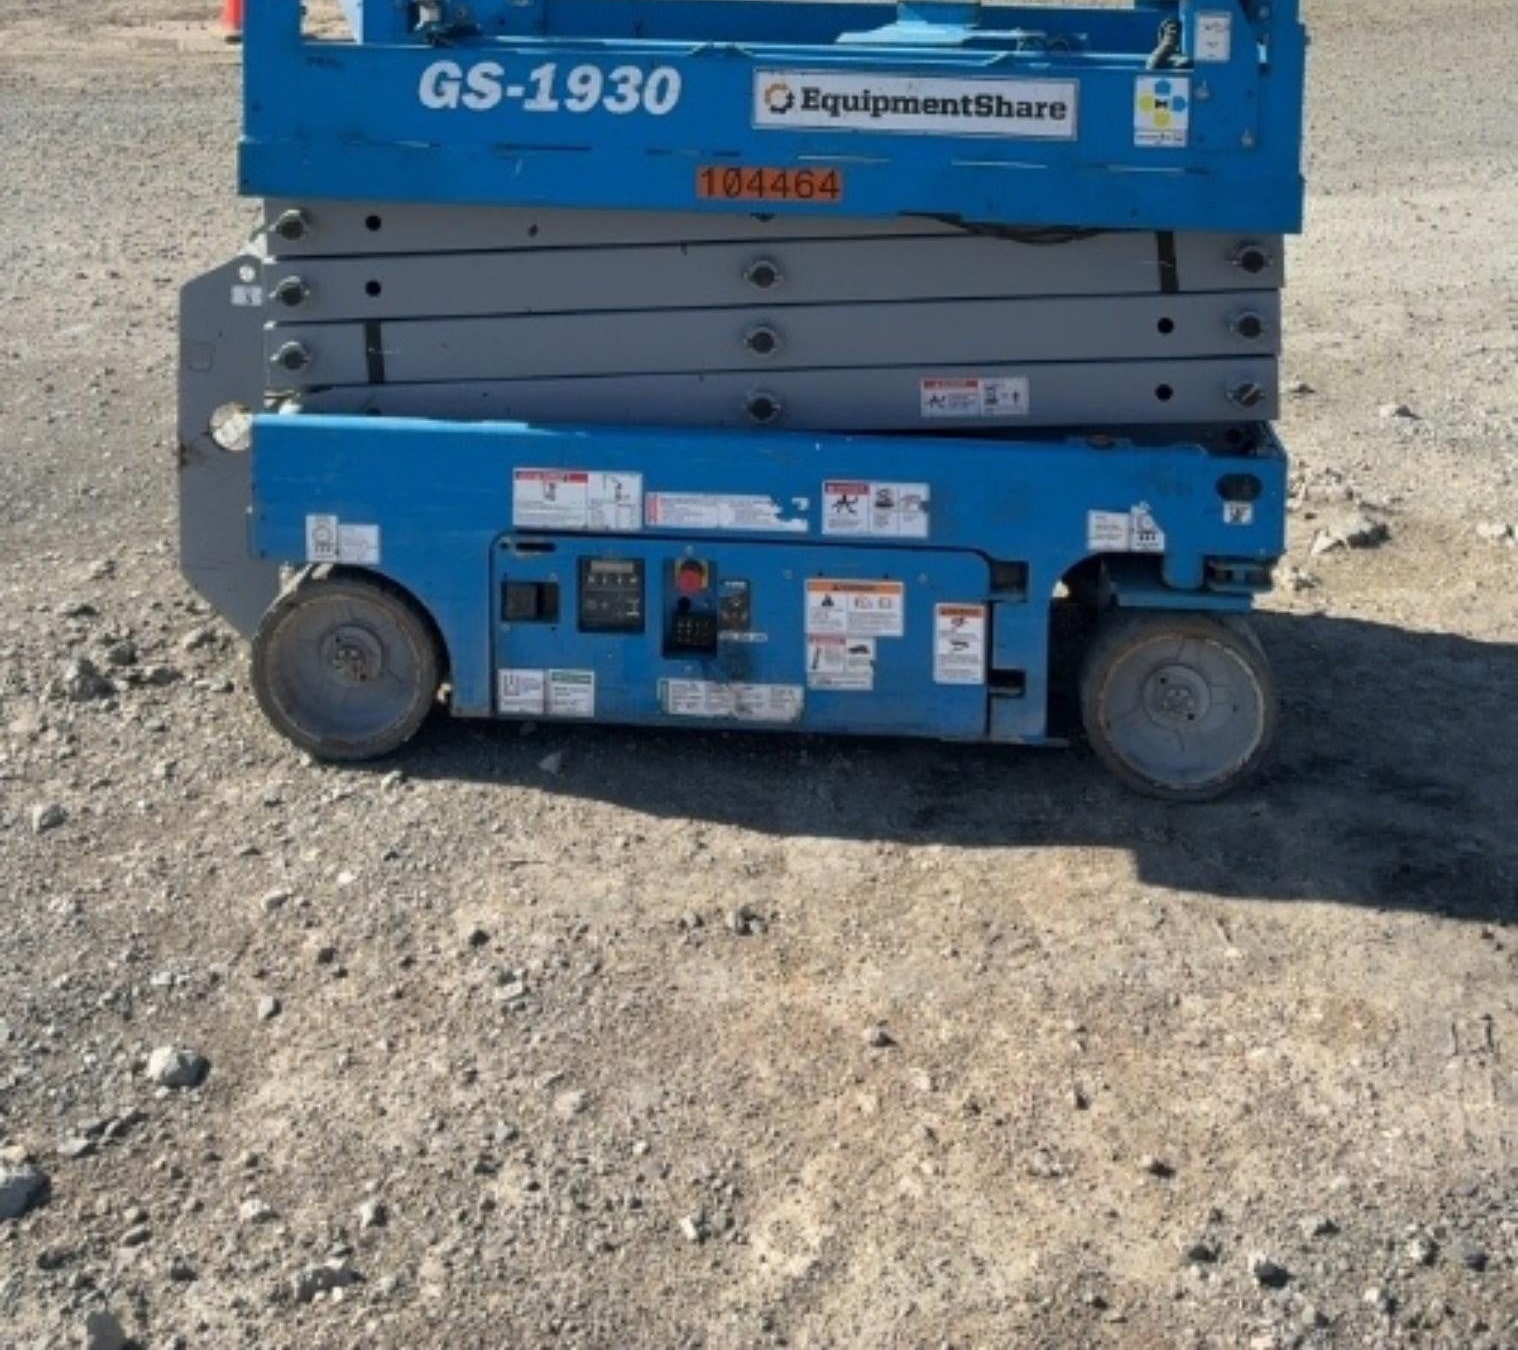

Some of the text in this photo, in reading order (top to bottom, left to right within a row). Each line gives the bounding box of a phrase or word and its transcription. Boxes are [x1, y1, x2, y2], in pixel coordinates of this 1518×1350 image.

[418, 59, 682, 115] GS-1930
[801, 86, 1067, 121] EquipmentShare
[701, 166, 841, 199] 104464
